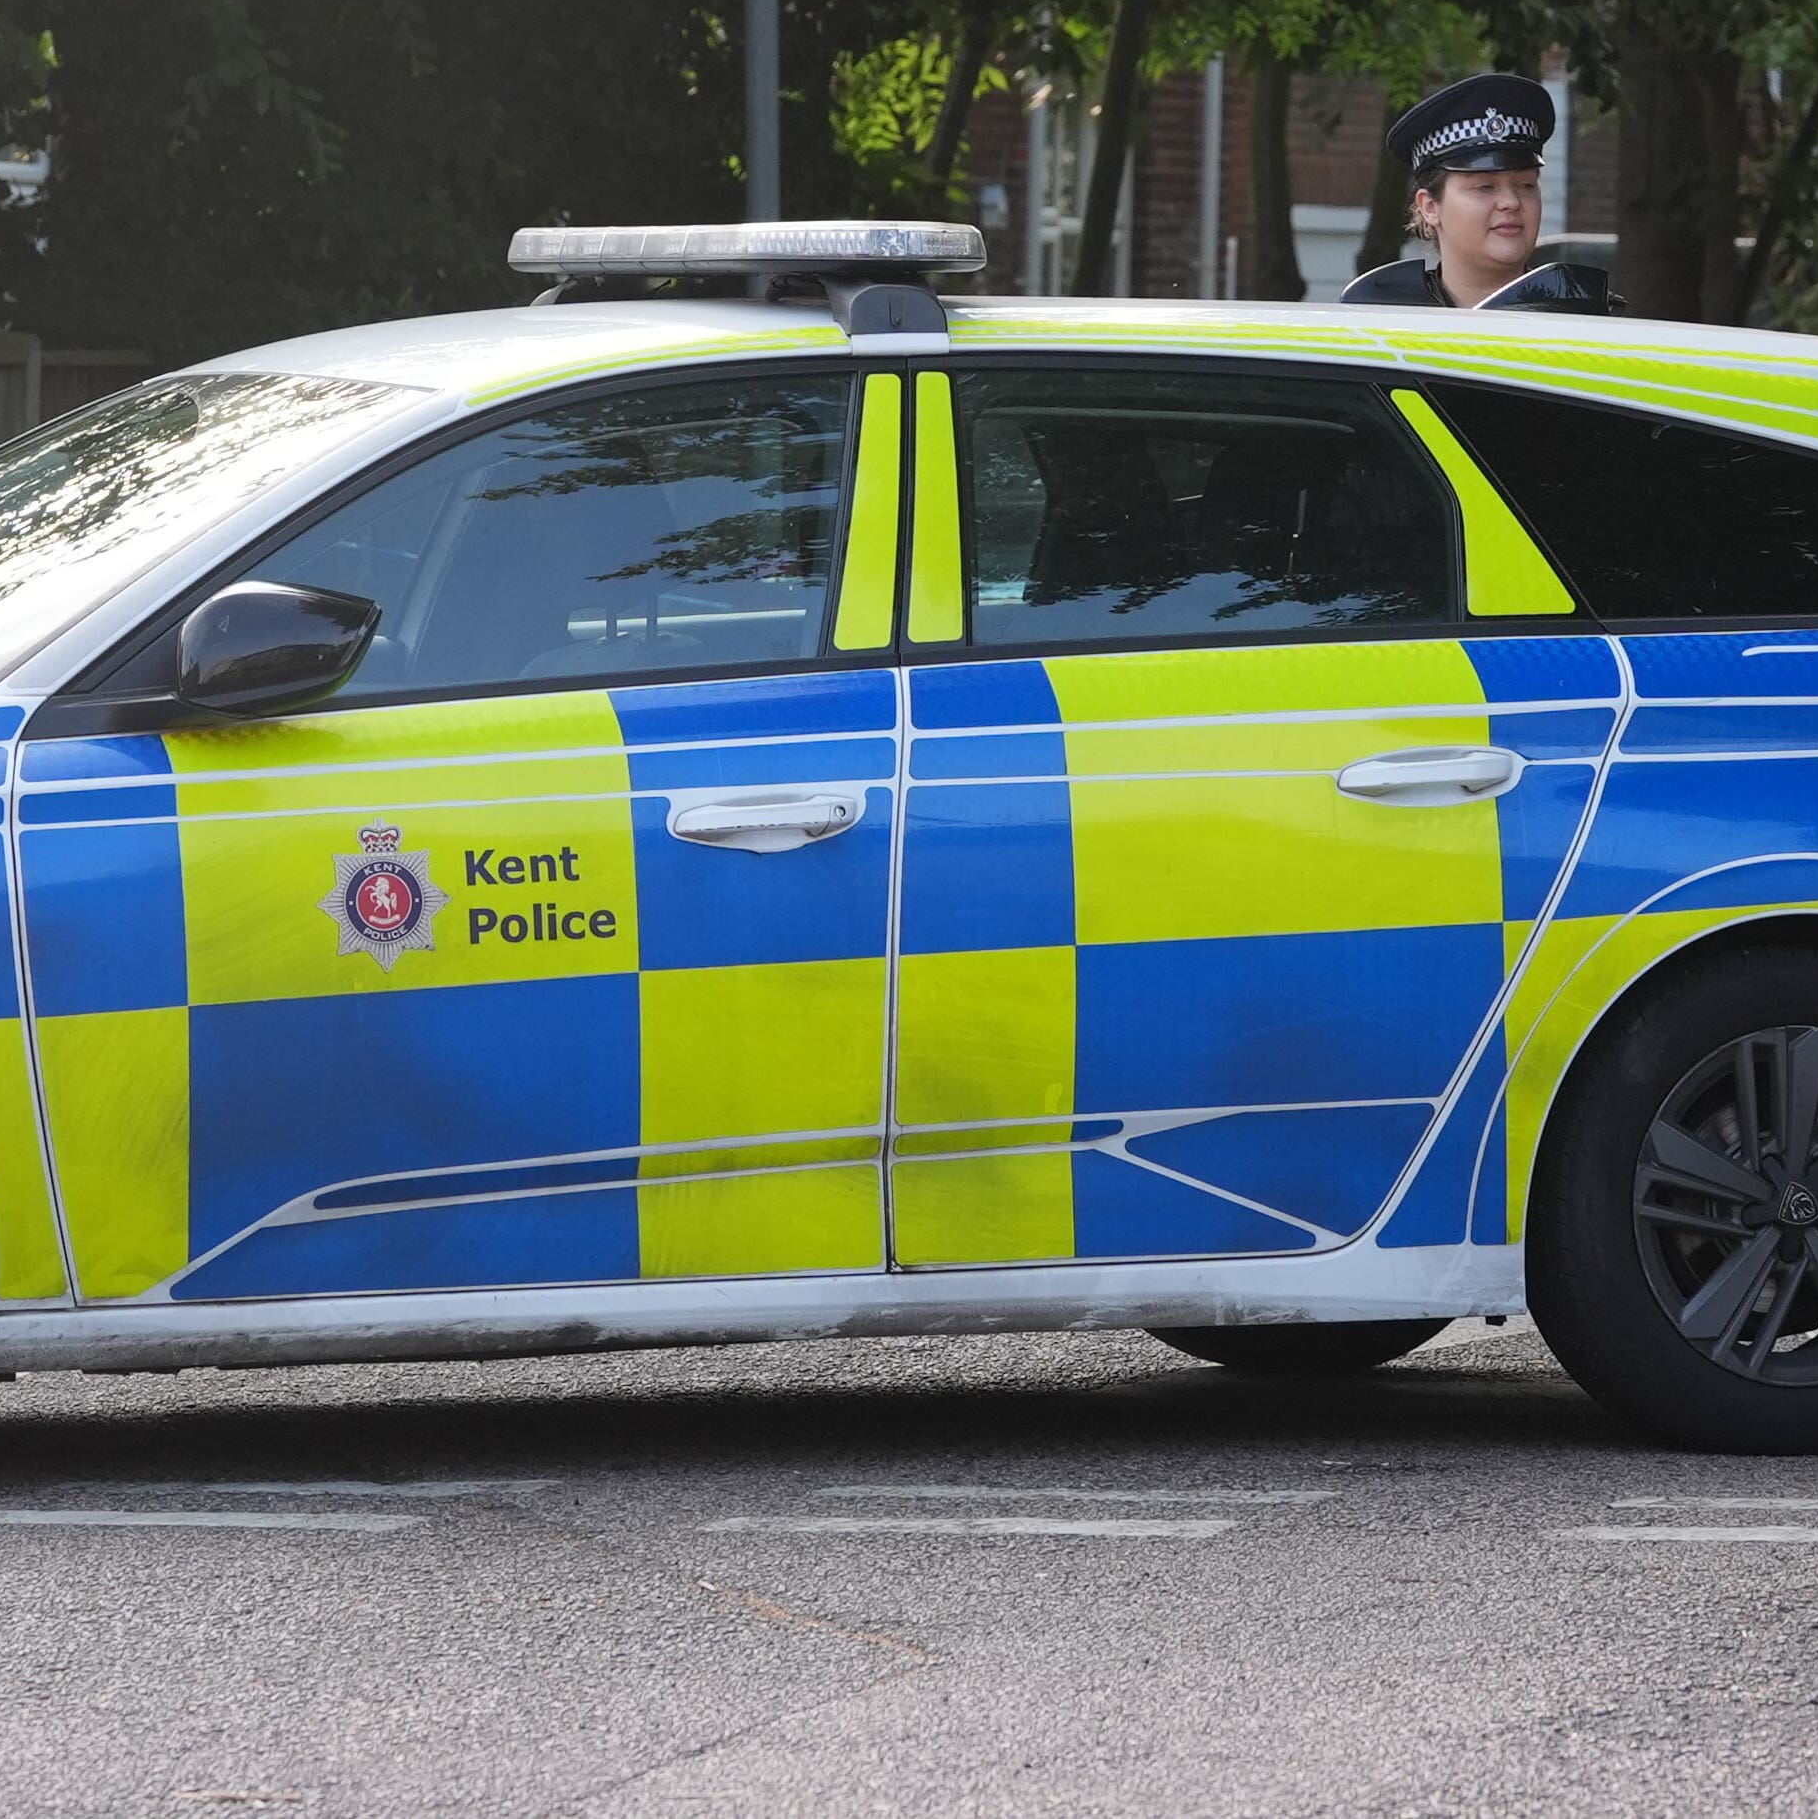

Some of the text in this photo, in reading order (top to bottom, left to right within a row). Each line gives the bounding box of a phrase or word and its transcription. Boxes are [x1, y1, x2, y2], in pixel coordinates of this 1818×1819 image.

[363, 863, 402, 876] KENT
[464, 846, 580, 886] Kent
[363, 925, 408, 941] POLICE
[468, 903, 616, 945] Police
